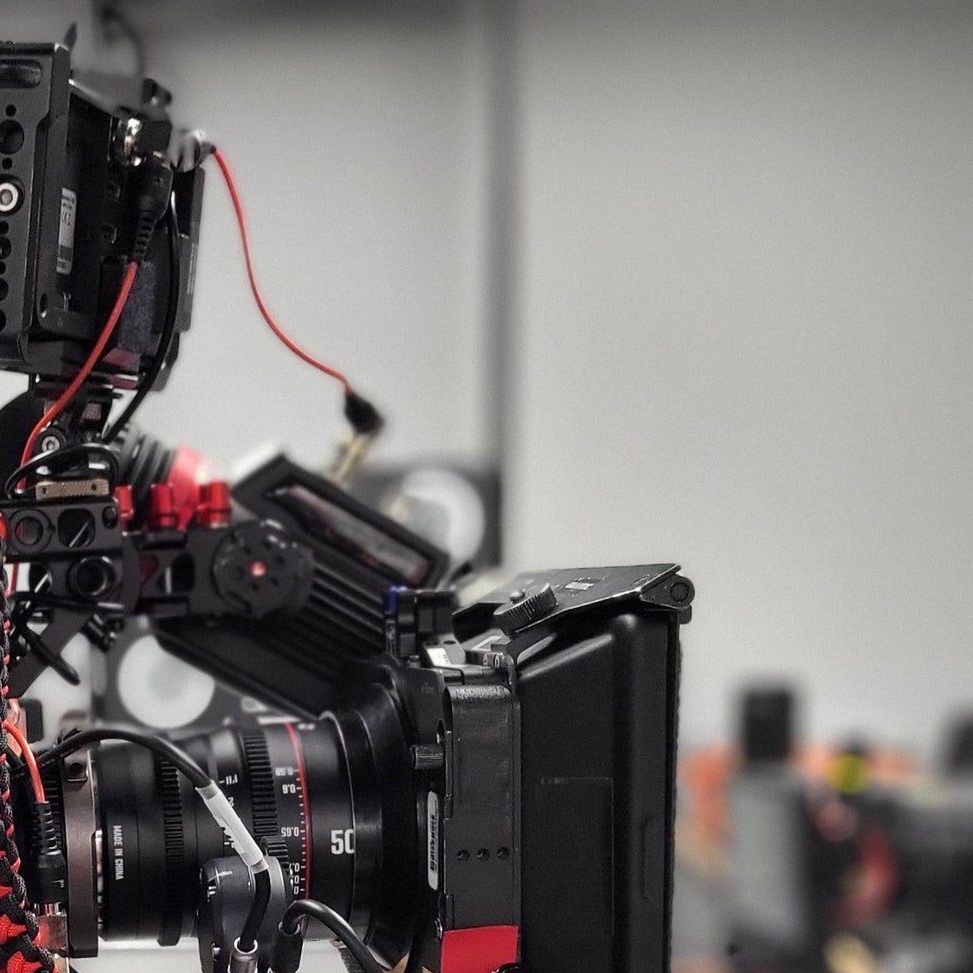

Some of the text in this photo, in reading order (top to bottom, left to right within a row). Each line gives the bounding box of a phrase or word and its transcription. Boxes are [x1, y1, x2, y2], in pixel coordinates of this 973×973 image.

[281, 826, 299, 837] 0.65
[113, 825, 124, 880] MADE IN CHINA
